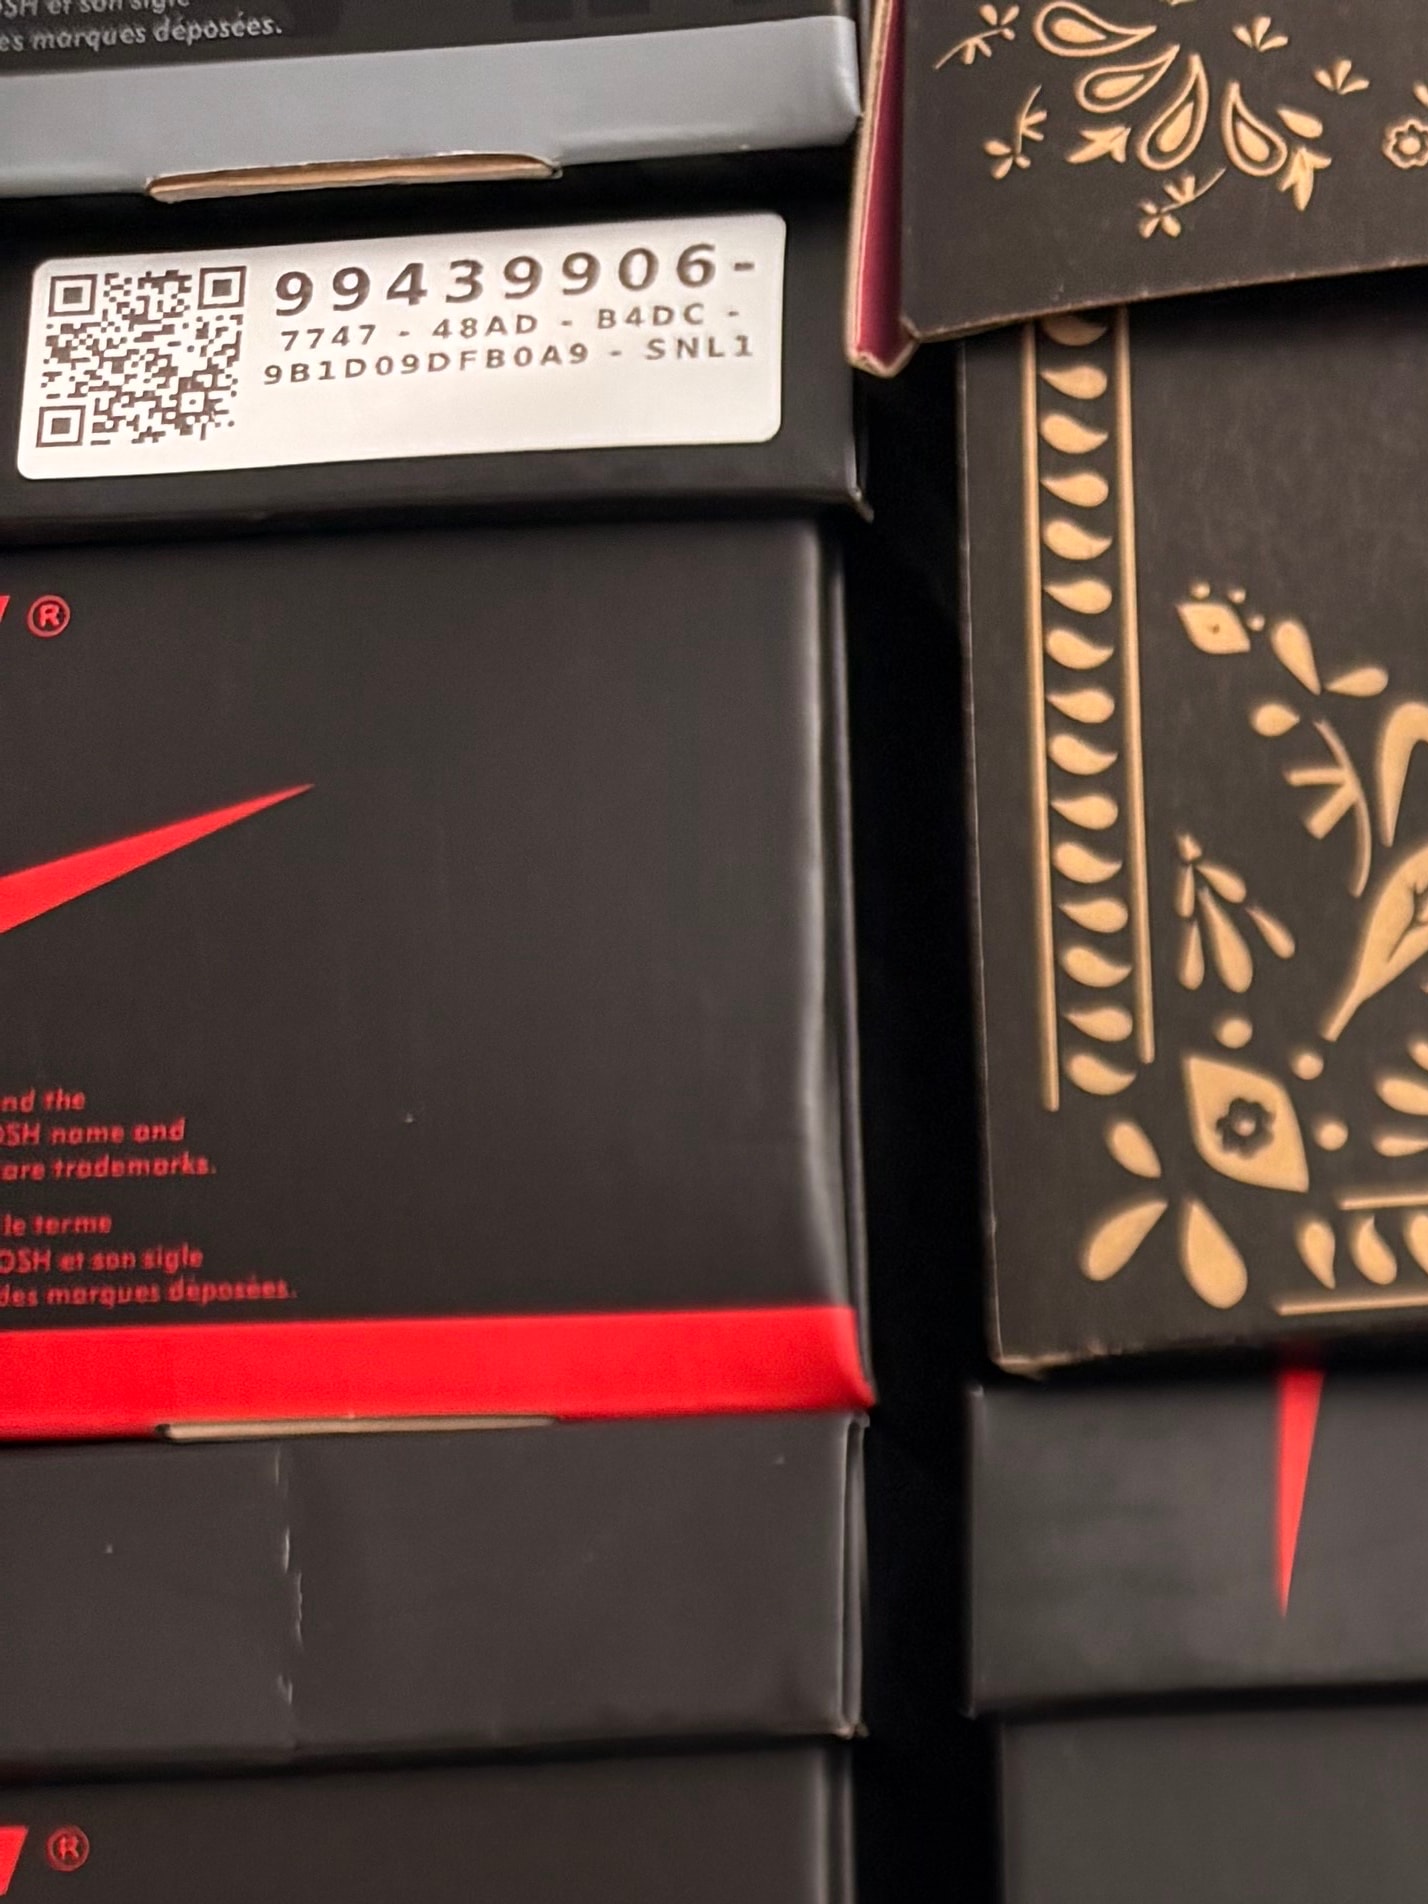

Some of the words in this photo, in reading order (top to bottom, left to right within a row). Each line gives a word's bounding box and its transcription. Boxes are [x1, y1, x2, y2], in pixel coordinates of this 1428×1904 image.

[31, 24, 147, 52] marques
[43, 1087, 86, 1111] the
[50, 1124, 125, 1145] name
[131, 1116, 186, 1143] and
[33, 1214, 112, 1235] terme
[58, 1252, 84, 1272] et
[90, 1252, 136, 1272] son
[141, 1243, 204, 1275] sigle
[46, 1285, 160, 1309] marques
